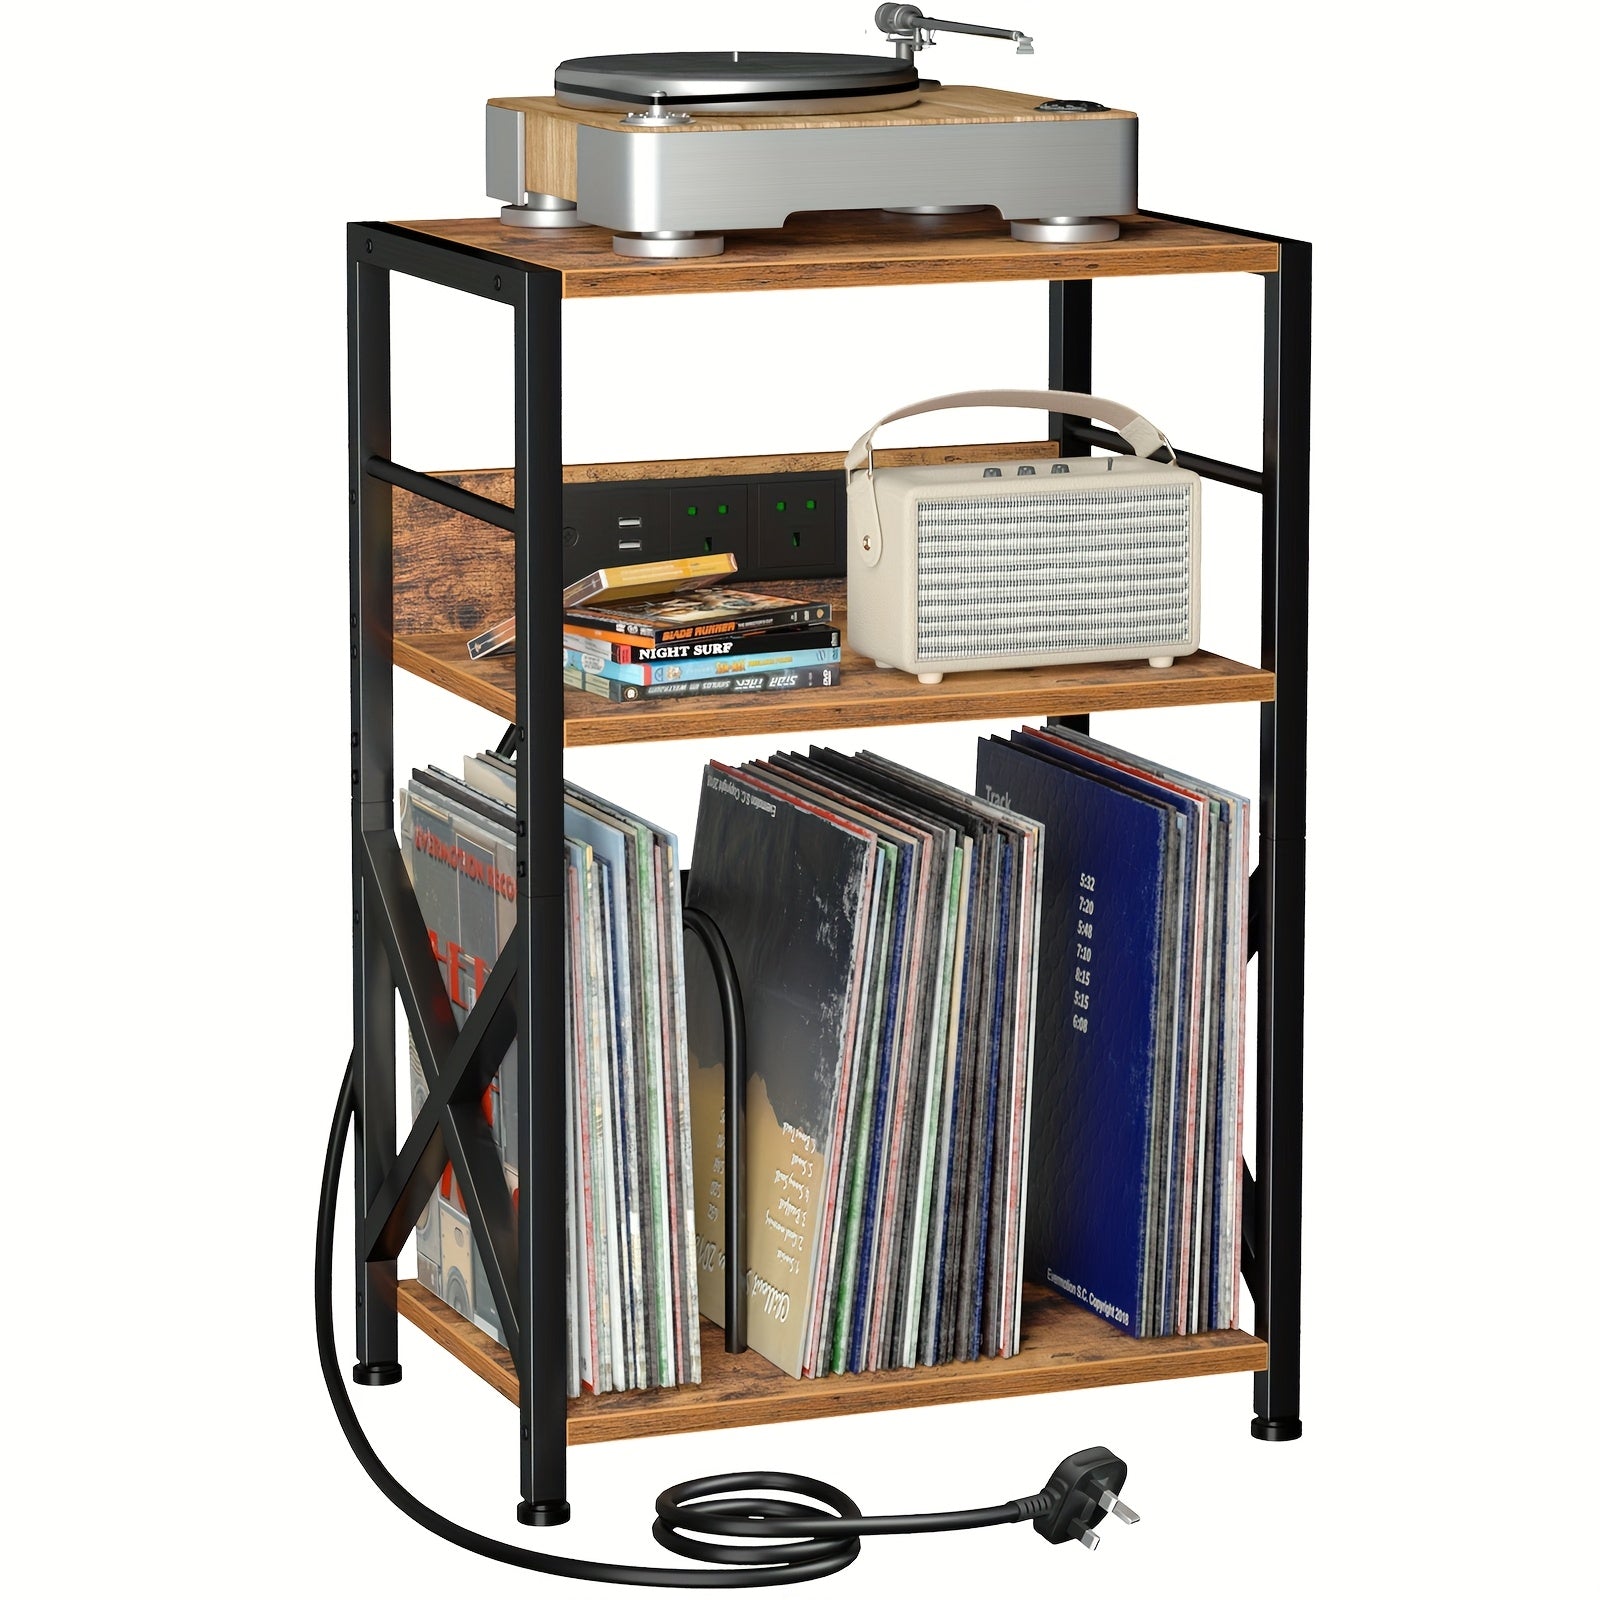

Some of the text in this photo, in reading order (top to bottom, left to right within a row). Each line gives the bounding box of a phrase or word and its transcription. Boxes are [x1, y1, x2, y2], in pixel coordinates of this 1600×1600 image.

[662, 628, 693, 641] BLADE
[694, 622, 736, 636] RUNNER
[639, 643, 690, 660] NIGHT
[693, 642, 733, 656] SURF
[734, 678, 764, 690] TREK
[769, 675, 798, 688] STAR
[985, 784, 1011, 809] Track
[1079, 872, 1095, 892] 5:32
[1079, 896, 1094, 915] 7:20
[1077, 921, 1092, 939] 5:48
[1076, 943, 1091, 962] 7:10
[1074, 967, 1090, 986] 8:15
[1073, 990, 1089, 1010] 5:15
[1072, 1014, 1088, 1034] 6:08
[751, 1272, 790, 1323] Chillout
[1088, 1292, 1114, 1318] Copyright
[1114, 1307, 1130, 1326] 2018
